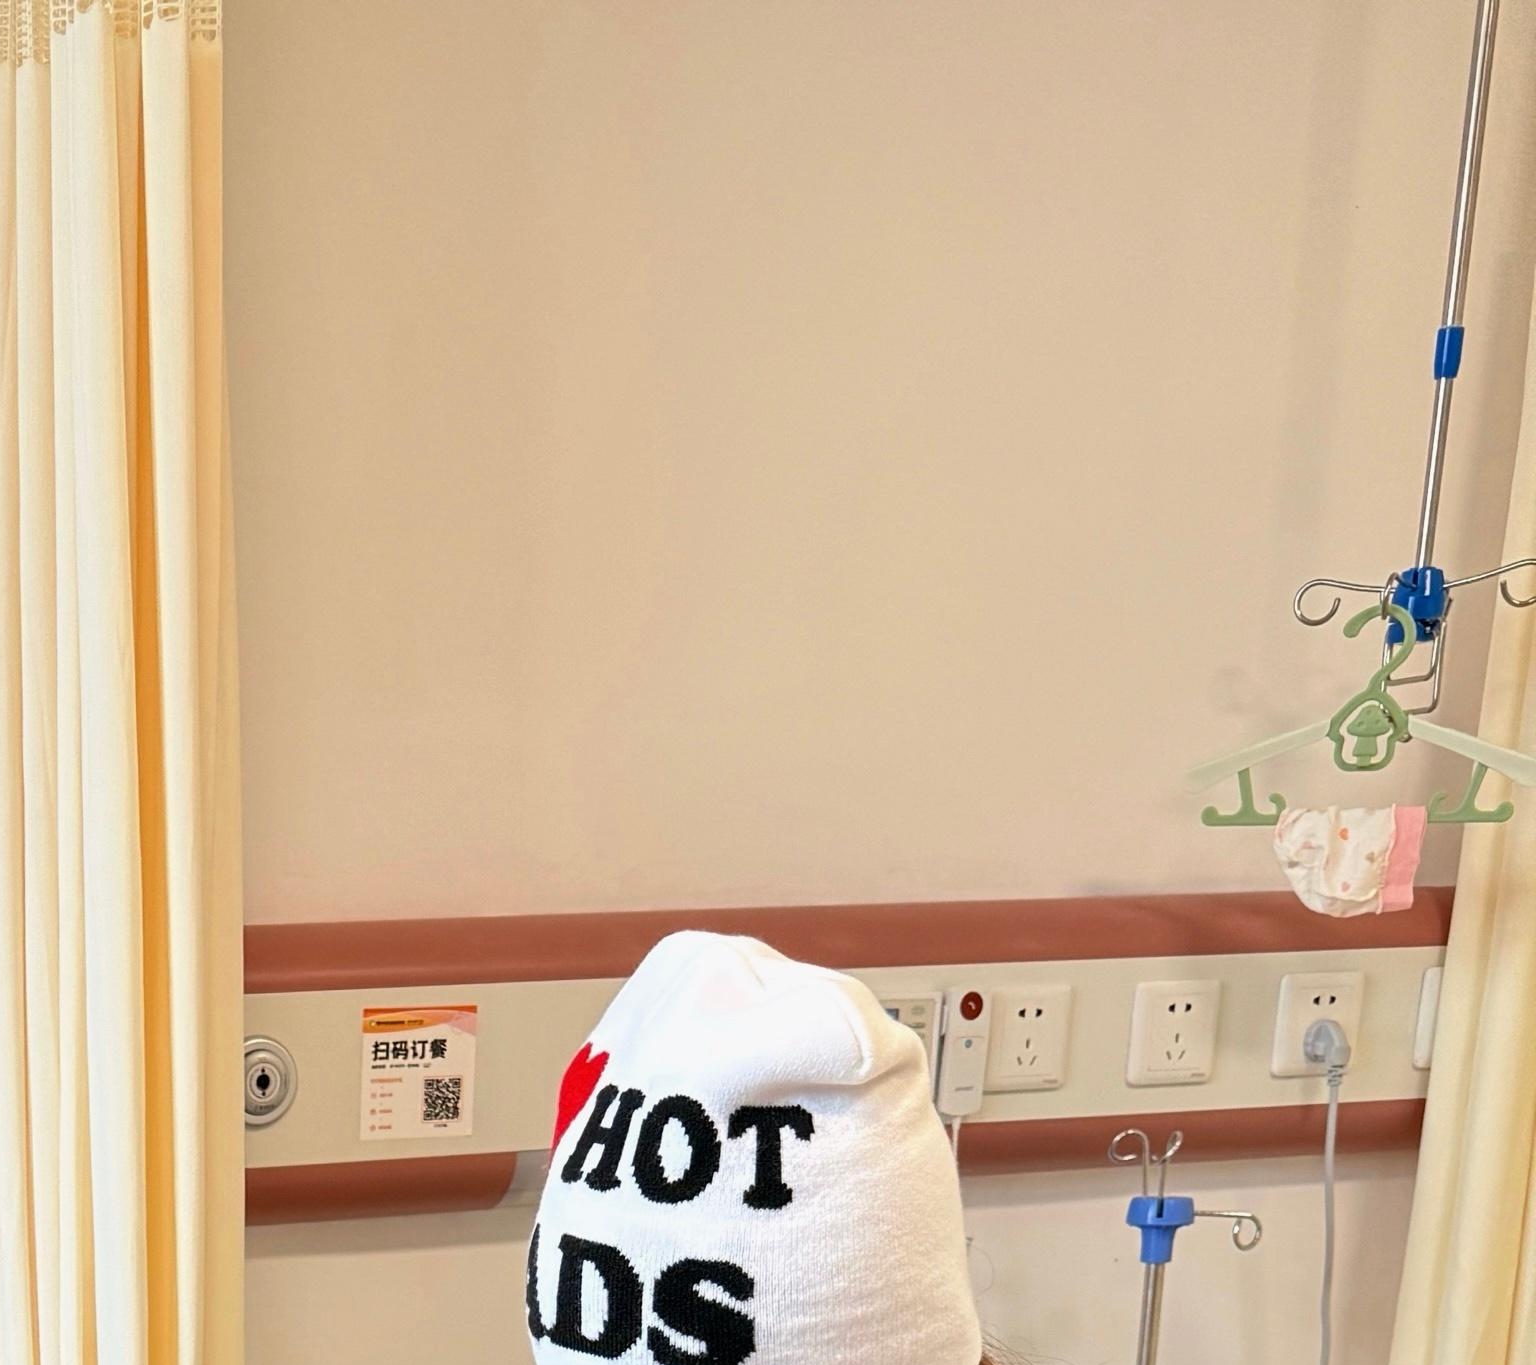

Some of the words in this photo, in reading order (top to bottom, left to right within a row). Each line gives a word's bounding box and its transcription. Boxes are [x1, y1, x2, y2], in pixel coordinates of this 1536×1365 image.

[371, 1039, 448, 1061] 扫码订餐
[560, 1083, 816, 1211] HOT
